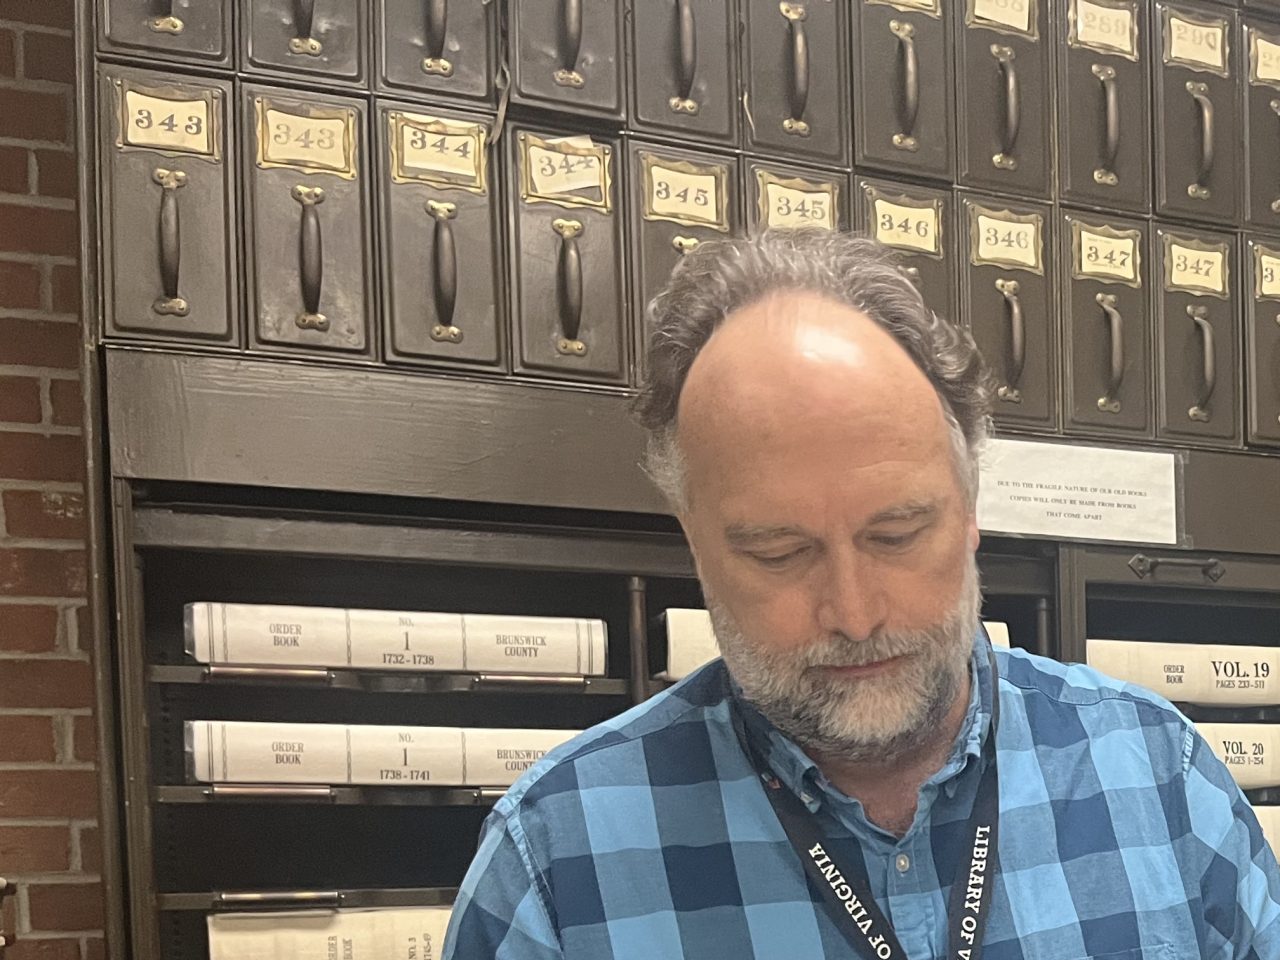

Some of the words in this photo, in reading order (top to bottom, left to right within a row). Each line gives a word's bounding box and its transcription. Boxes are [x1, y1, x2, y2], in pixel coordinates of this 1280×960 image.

[135, 108, 202, 136] 343
[273, 123, 336, 150] 343
[410, 130, 471, 159] 344
[539, 154, 596, 177] 344
[656, 181, 709, 206] 345
[777, 196, 826, 220] 345
[880, 213, 929, 237] 346
[985, 227, 1029, 250] 346
[1087, 246, 1131, 267] 347
[1175, 255, 1215, 277] 347
[268, 624, 302, 636] ORDER
[495, 634, 547, 647] BRUNSWICK
[273, 636, 300, 648] BOOK
[403, 632, 410, 651] 1
[504, 646, 539, 658] COUNTY
[1163, 664, 1185, 674] ORDER
[1166, 675, 1184, 684] BOOK
[1211, 660, 1250, 678] VOL.
[1252, 662, 1270, 678] 19
[1215, 679, 1236, 689] PAGES
[272, 742, 304, 754] ORDER
[402, 748, 408, 766] 1
[1252, 742, 1264, 756] 20
[275, 753, 302, 765] BOOK
[1225, 756, 1246, 764] PAGES
[964, 825, 991, 914] LIBRARY
[808, 842, 873, 934] VIRGINIA
[960, 916, 977, 944] OF
[343, 938, 353, 960] BOOK
[868, 933, 892, 960] OF
